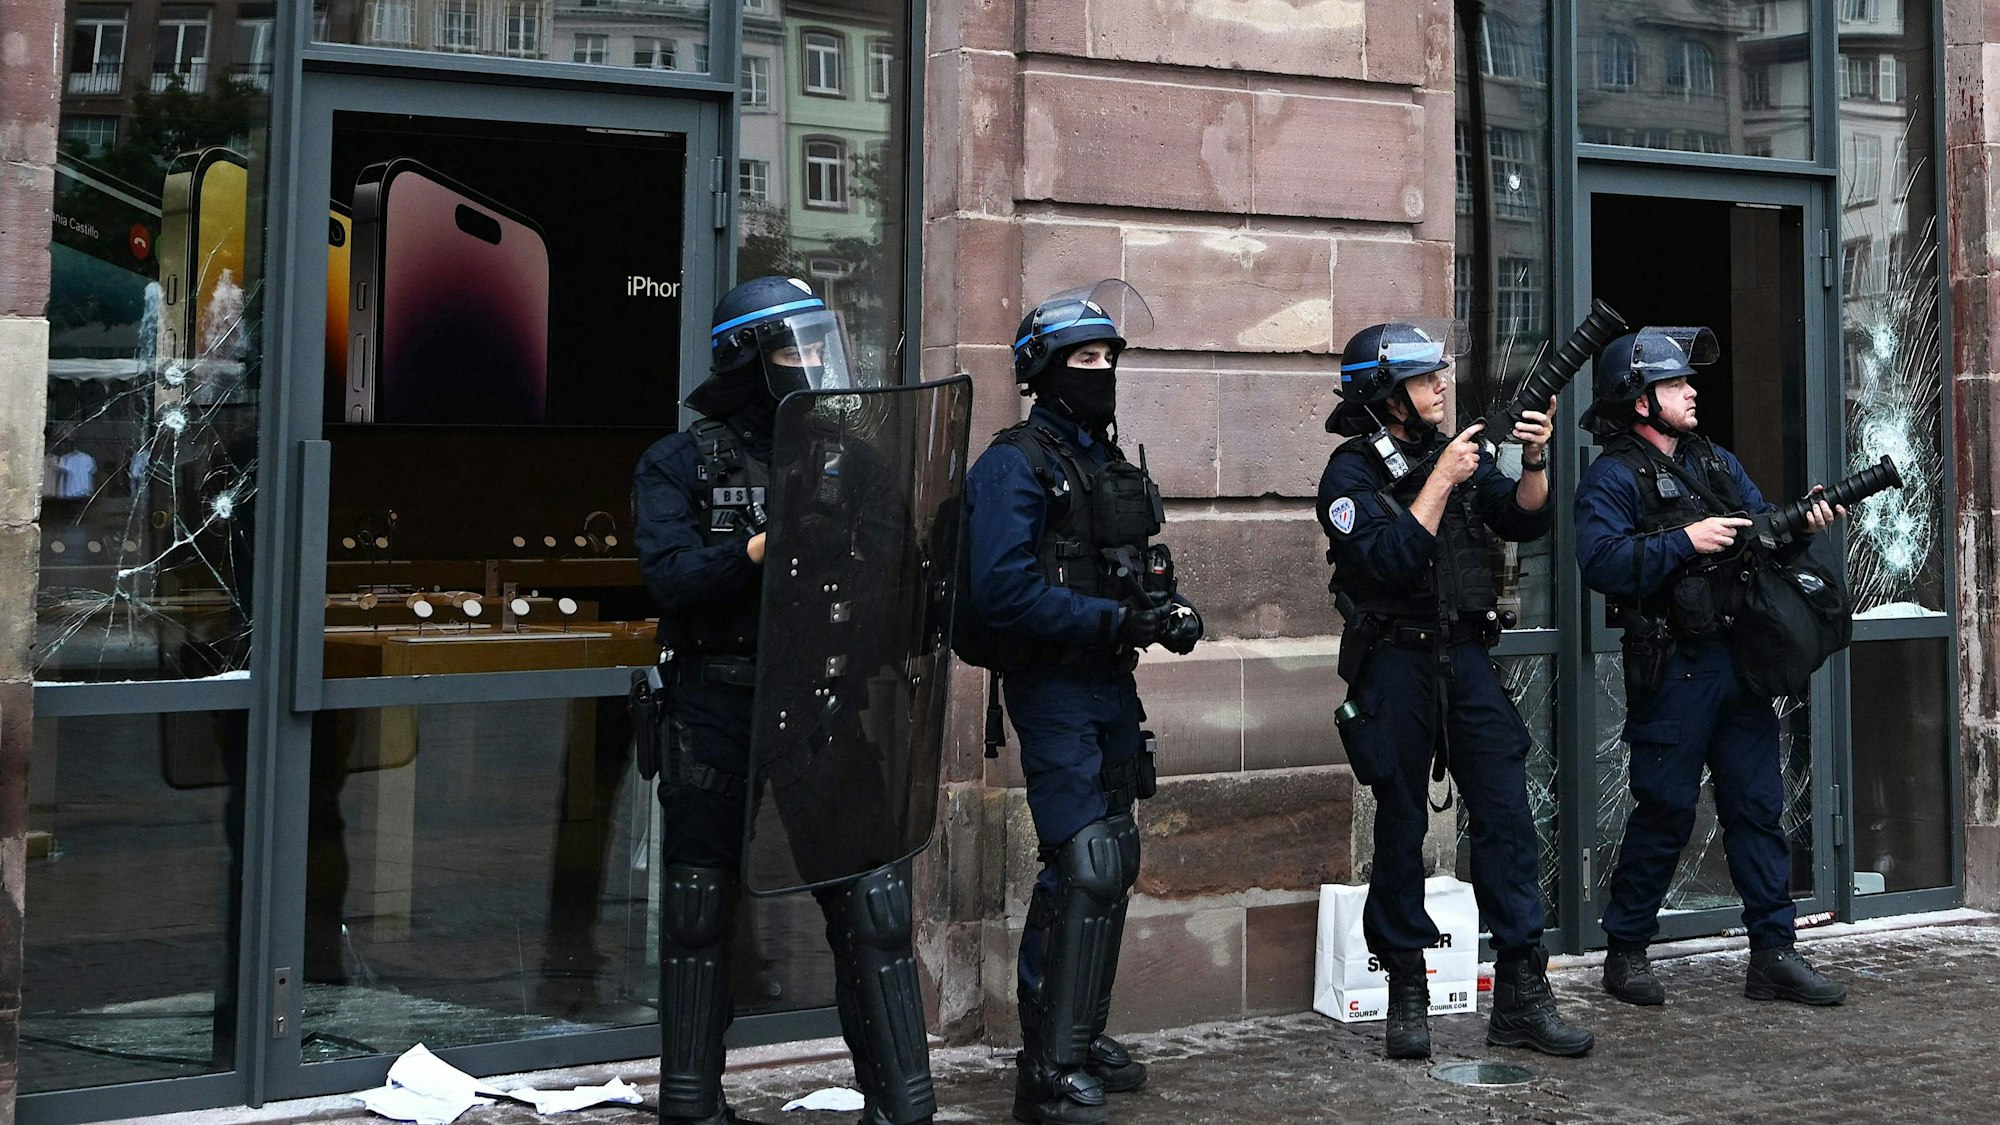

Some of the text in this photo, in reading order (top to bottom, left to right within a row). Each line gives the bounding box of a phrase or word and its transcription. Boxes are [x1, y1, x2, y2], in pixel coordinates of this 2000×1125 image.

[69, 217, 99, 239] Castillo
[723, 490, 755, 502] BS
[1429, 1003, 1467, 1011] COURIR.COM
[1349, 1010, 1378, 1018] COURIR
